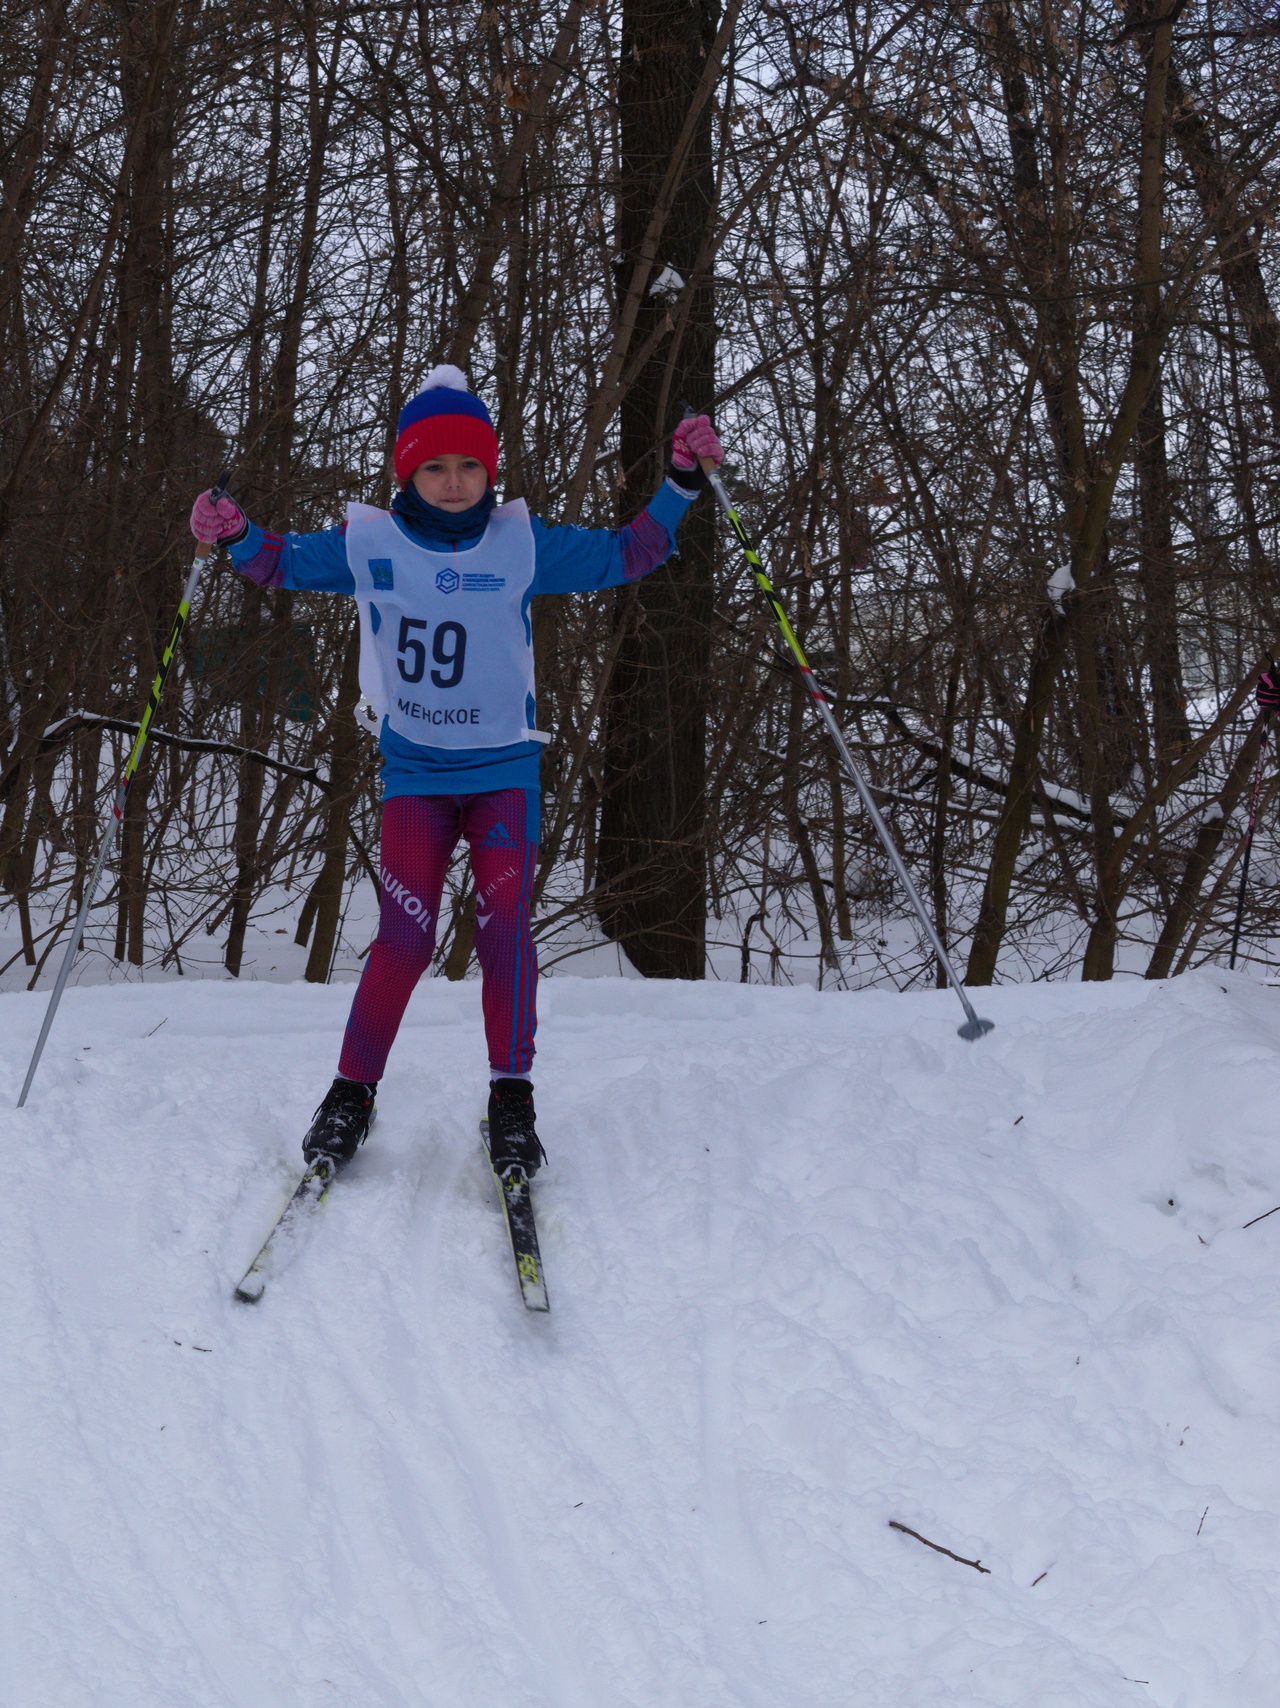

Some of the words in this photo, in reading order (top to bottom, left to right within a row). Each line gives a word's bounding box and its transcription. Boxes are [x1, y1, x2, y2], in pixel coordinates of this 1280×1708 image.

[397, 615, 467, 688] 59
[397, 698, 480, 725] МЕНСКОЕ
[381, 867, 431, 933] LUKOIL
